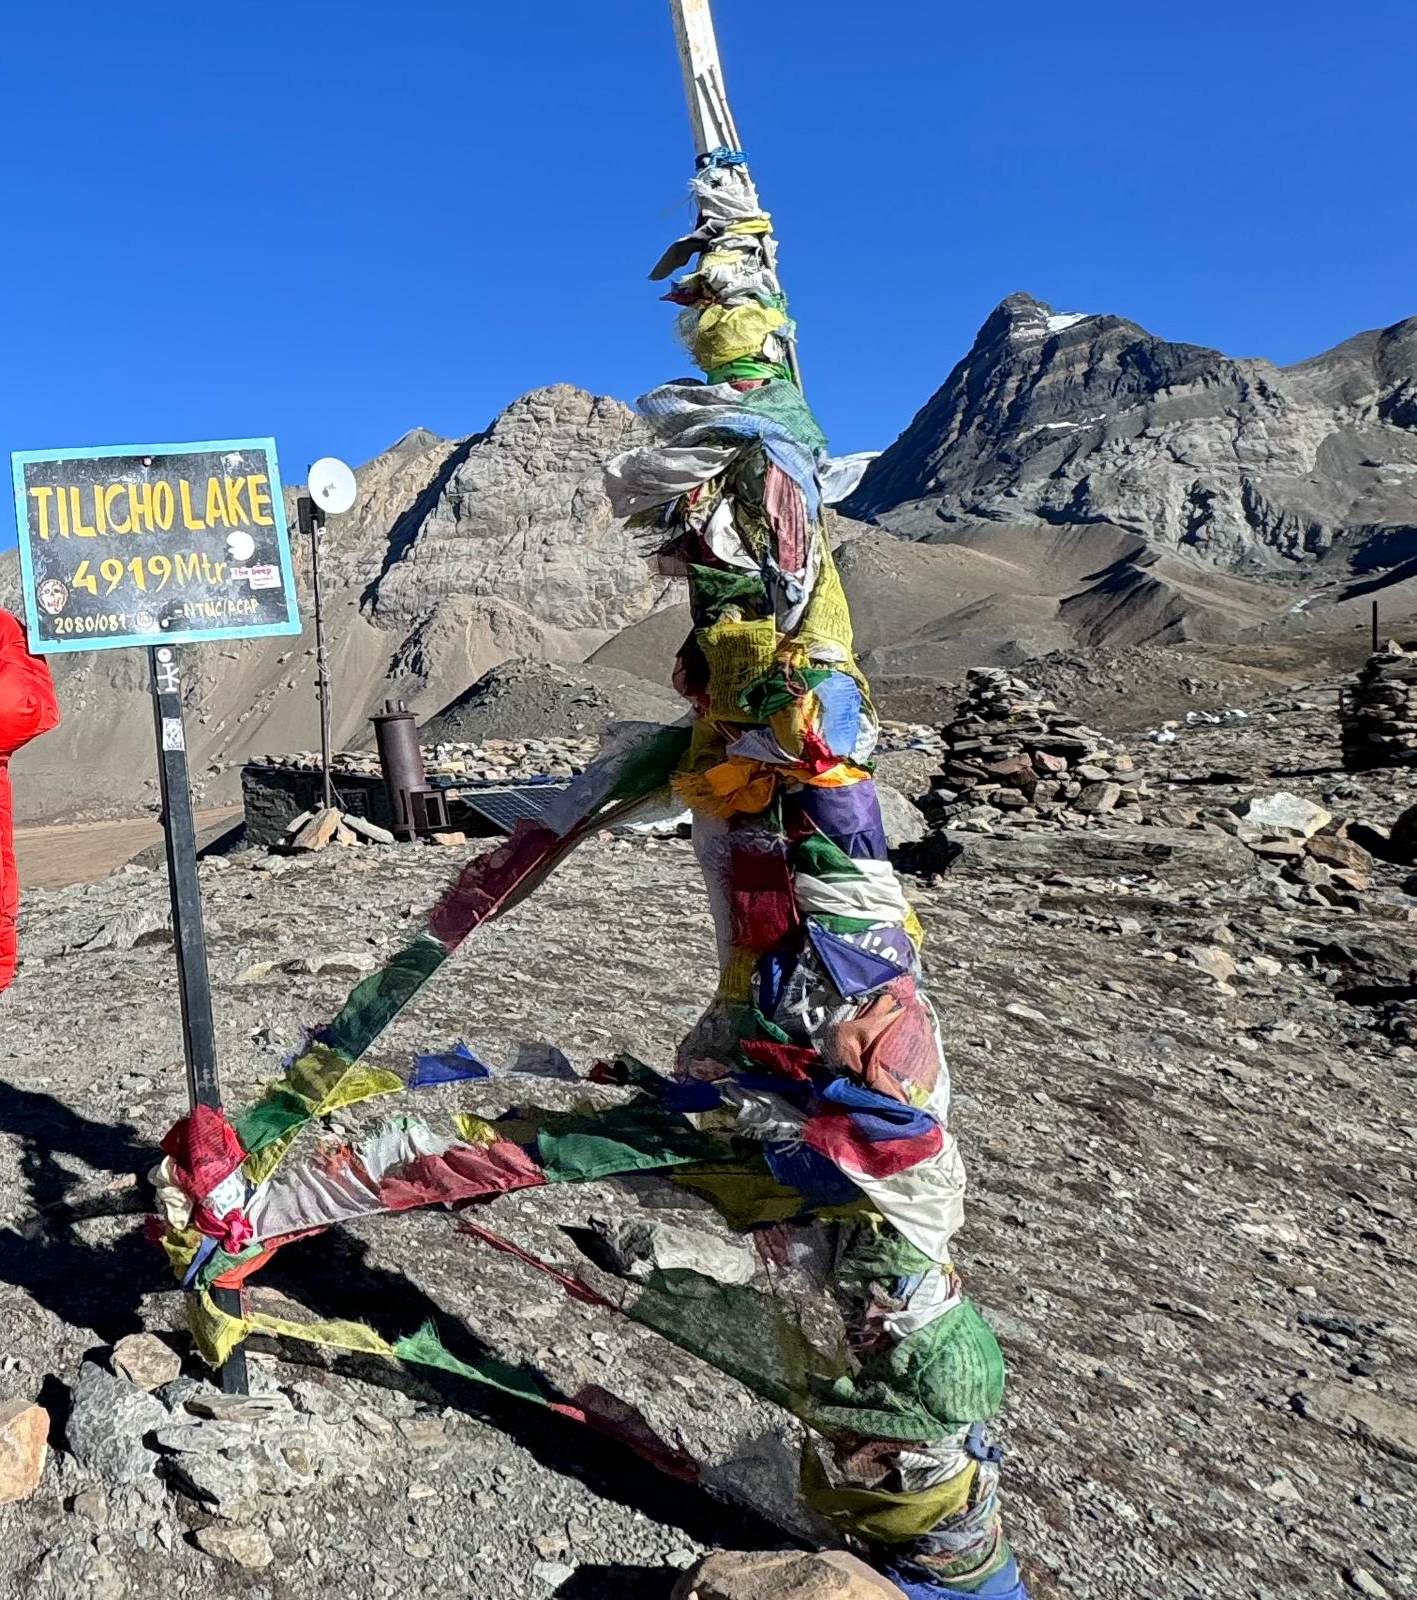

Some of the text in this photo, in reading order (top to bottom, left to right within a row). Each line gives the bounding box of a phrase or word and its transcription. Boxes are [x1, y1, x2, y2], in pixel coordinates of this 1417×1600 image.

[29, 474, 274, 540] TILICHO LAKE
[54, 614, 127, 634] 2080/081
